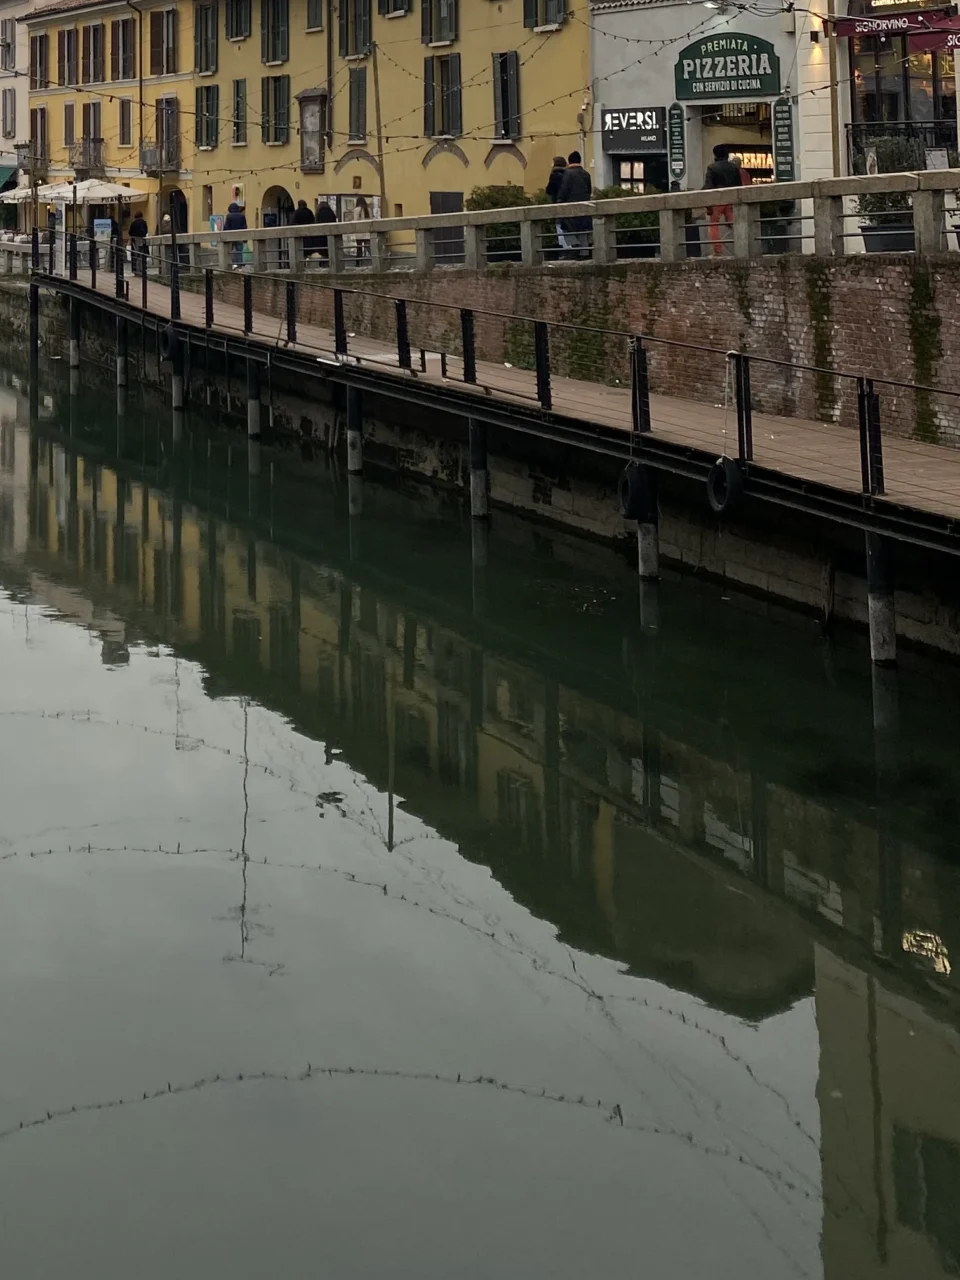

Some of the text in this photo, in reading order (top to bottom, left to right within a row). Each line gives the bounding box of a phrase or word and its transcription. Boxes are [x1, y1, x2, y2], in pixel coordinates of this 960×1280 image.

[855, 18, 909, 32] SIGNORVINO
[701, 38, 748, 55] PREMIATA
[682, 53, 772, 79] PIZZERIA
[692, 78, 761, 93] CON SERVIZIO DI CUCINA
